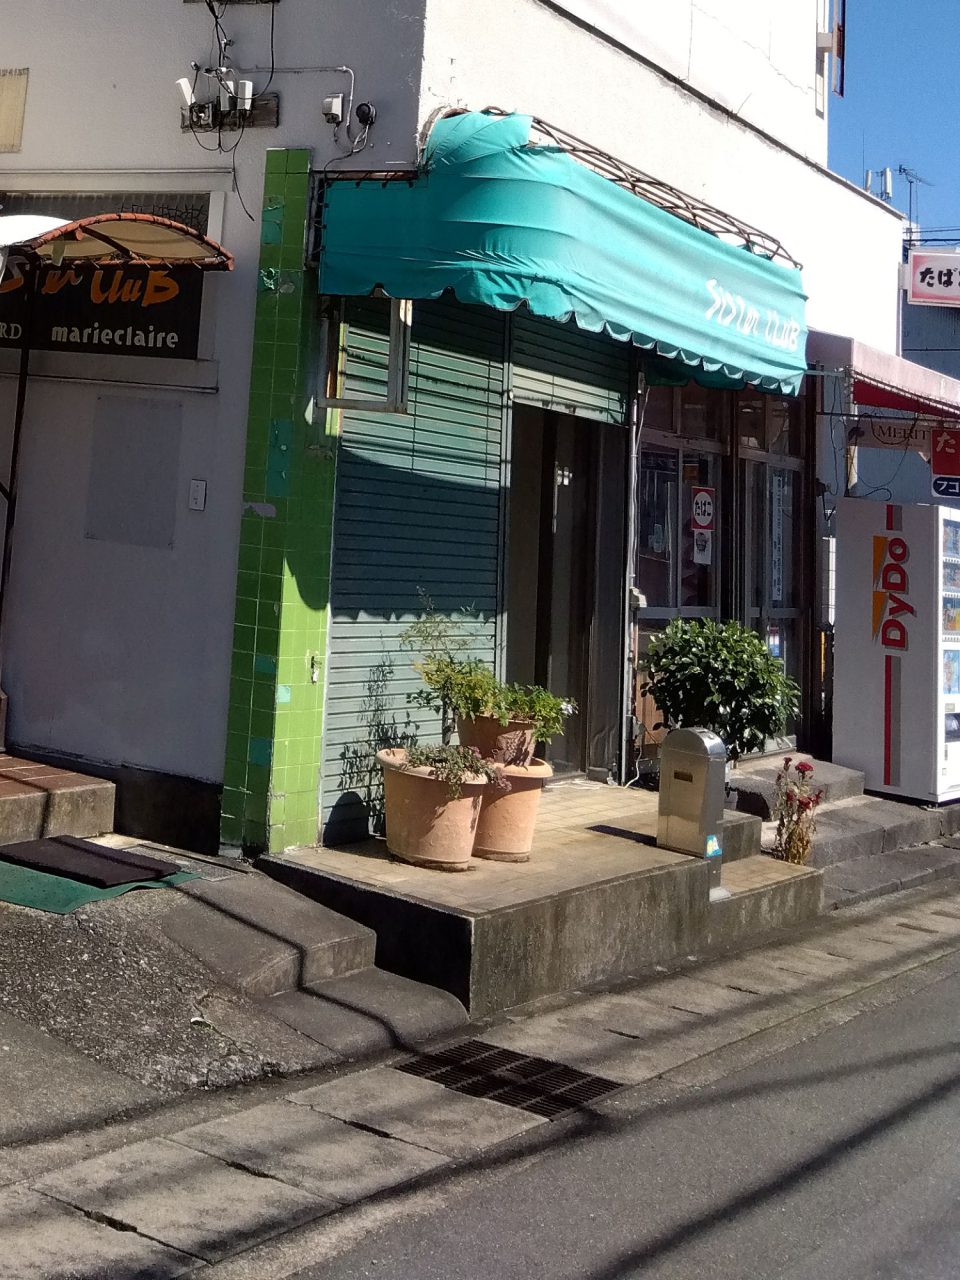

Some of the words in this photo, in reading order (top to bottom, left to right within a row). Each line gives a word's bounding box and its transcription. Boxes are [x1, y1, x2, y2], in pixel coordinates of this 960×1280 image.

[919, 267, 960, 288] たば
[694, 500, 712, 517] たばこ
[881, 537, 917, 650] DyDo
